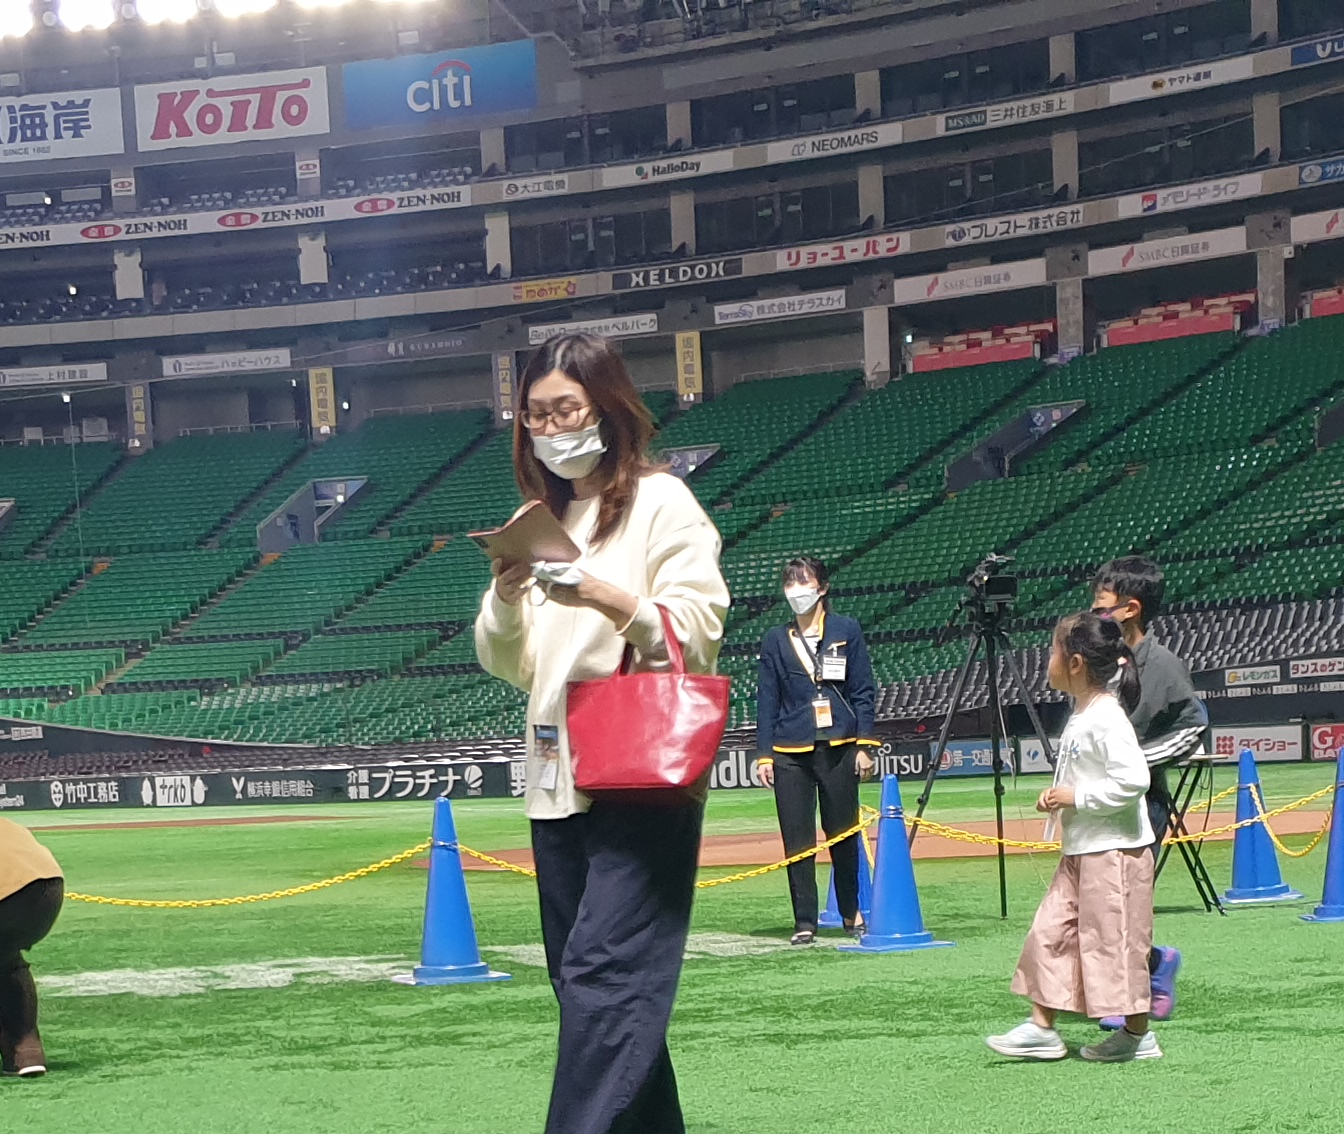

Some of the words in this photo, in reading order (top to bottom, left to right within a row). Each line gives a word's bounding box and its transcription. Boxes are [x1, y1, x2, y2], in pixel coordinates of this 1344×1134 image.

[406, 60, 474, 115] citi
[990, 98, 1067, 122] 三井住友海上
[811, 131, 879, 153] NEOMARS
[397, 191, 462, 209] ZEN-NOH
[261, 206, 325, 223] ZEN-NOH
[124, 219, 188, 235] ZEN-NOH
[786, 236, 900, 266] リョーユーパン
[1242, 671, 1279, 682] レモンガス
[1239, 738, 1298, 751] ダイショー
[65, 781, 120, 804] 竹中工務店
[372, 768, 462, 799] プラチナ
